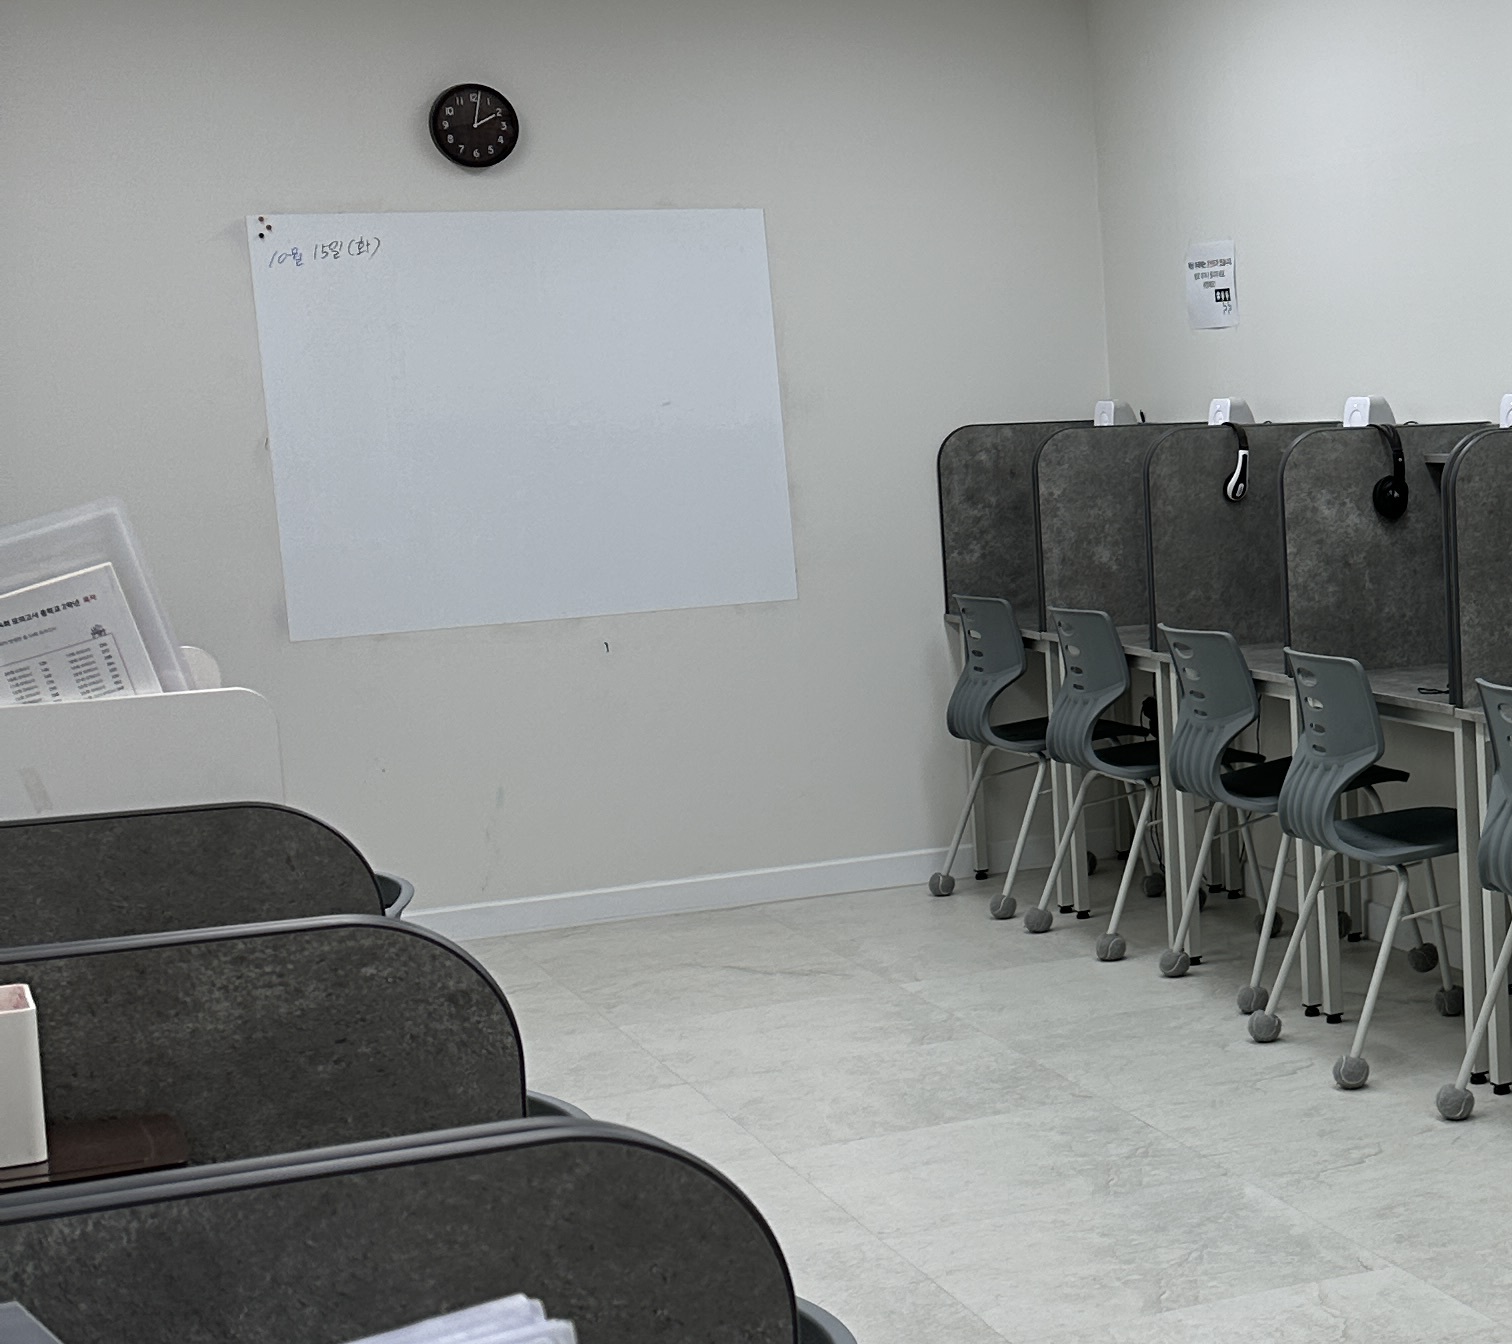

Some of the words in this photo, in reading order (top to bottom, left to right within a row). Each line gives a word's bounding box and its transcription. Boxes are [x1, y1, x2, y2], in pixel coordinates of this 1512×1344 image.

[455, 96, 464, 106] 11
[469, 93, 479, 103] 12
[486, 97, 491, 106] 1
[445, 106, 454, 116] 10
[496, 108, 502, 117] 2
[442, 120, 449, 130] 9
[500, 121, 507, 131] 3
[447, 134, 454, 144] 8
[497, 135, 504, 144] 4
[458, 144, 465, 154] 7
[473, 148, 480, 158] 6
[487, 145, 494, 154] 5
[269, 246, 304, 268] 10월
